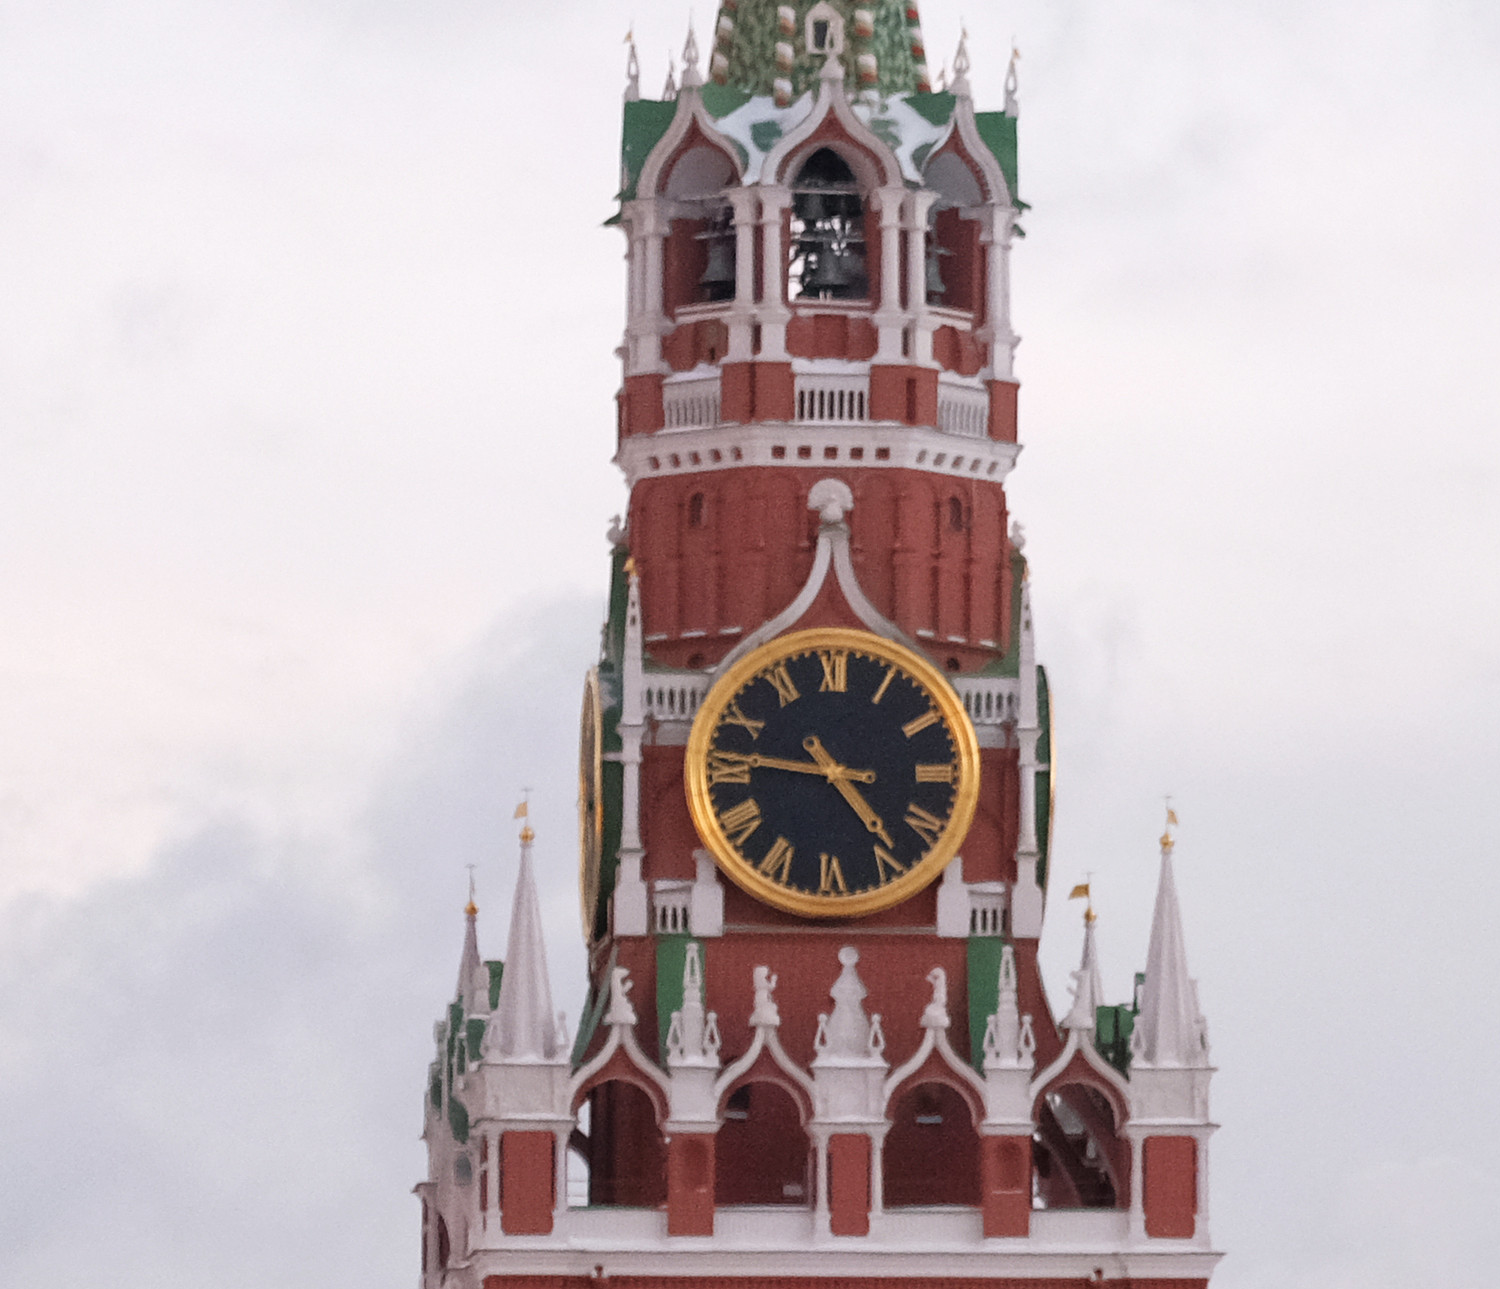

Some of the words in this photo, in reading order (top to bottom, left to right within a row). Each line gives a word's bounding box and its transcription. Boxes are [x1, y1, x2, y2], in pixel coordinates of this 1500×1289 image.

[764, 664, 800, 707] XI
[819, 649, 848, 693] XII
[871, 664, 897, 705] I
[721, 702, 766, 740] X
[902, 710, 942, 738] II
[915, 763, 952, 783] III
[719, 798, 762, 845] VIII
[904, 802, 947, 847] IV
[757, 836, 795, 885] VII
[820, 853, 847, 894] VI
[873, 843, 905, 886] V
